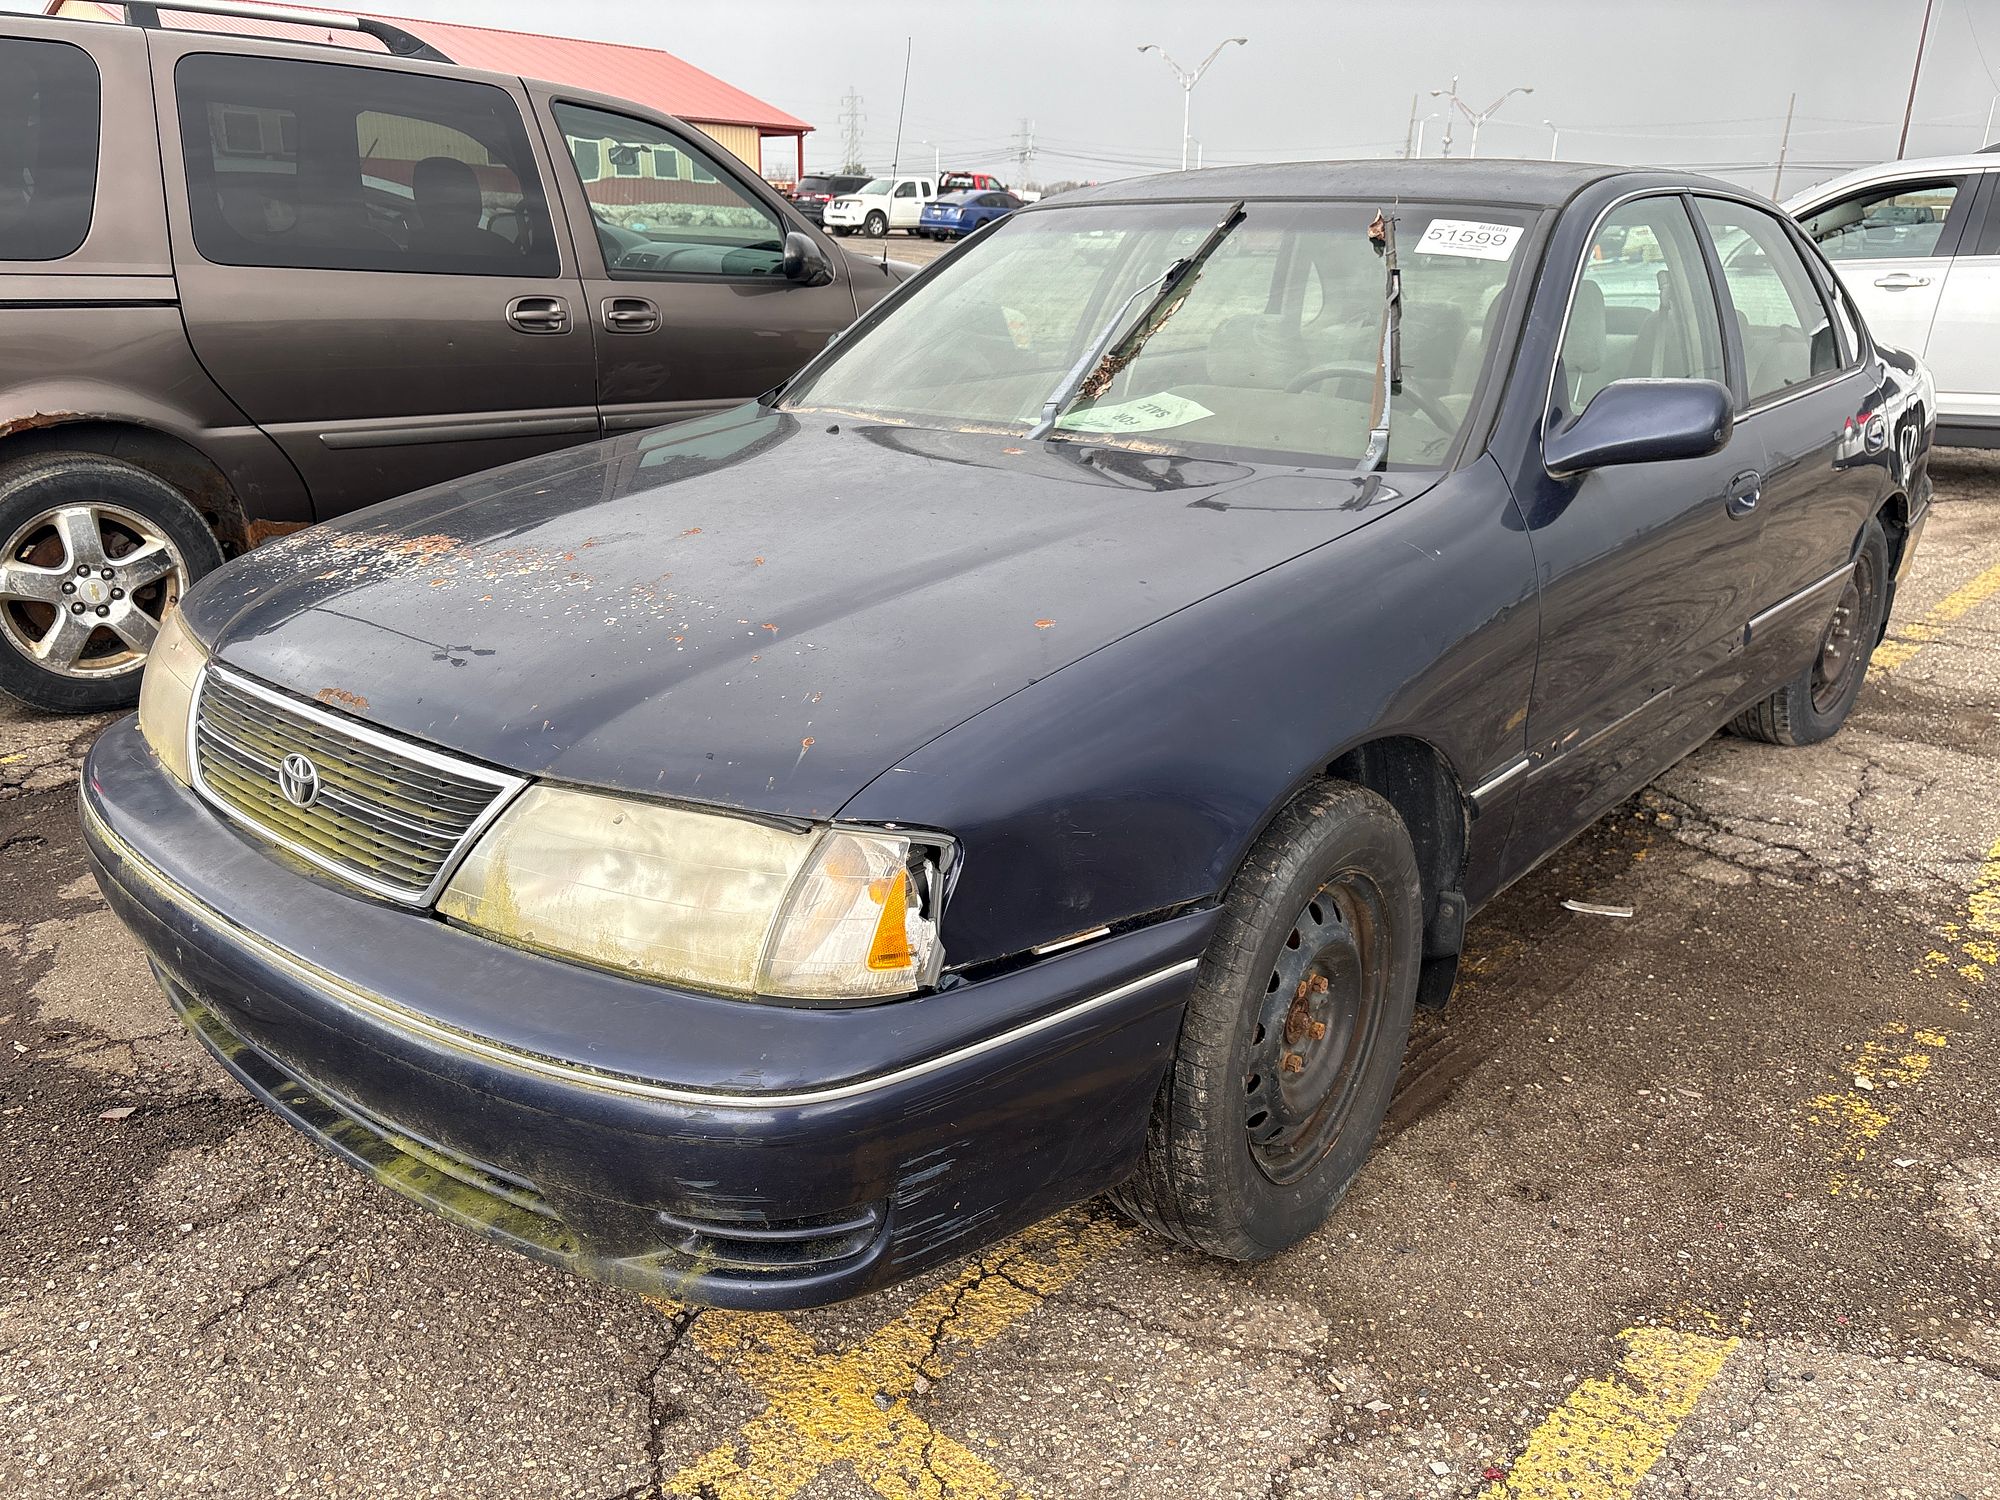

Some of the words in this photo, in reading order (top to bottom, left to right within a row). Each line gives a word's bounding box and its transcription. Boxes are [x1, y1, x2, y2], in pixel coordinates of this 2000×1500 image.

[1428, 228, 1507, 246] 51599
[1137, 403, 1171, 418] SALE
[1112, 413, 1141, 426] FOR
